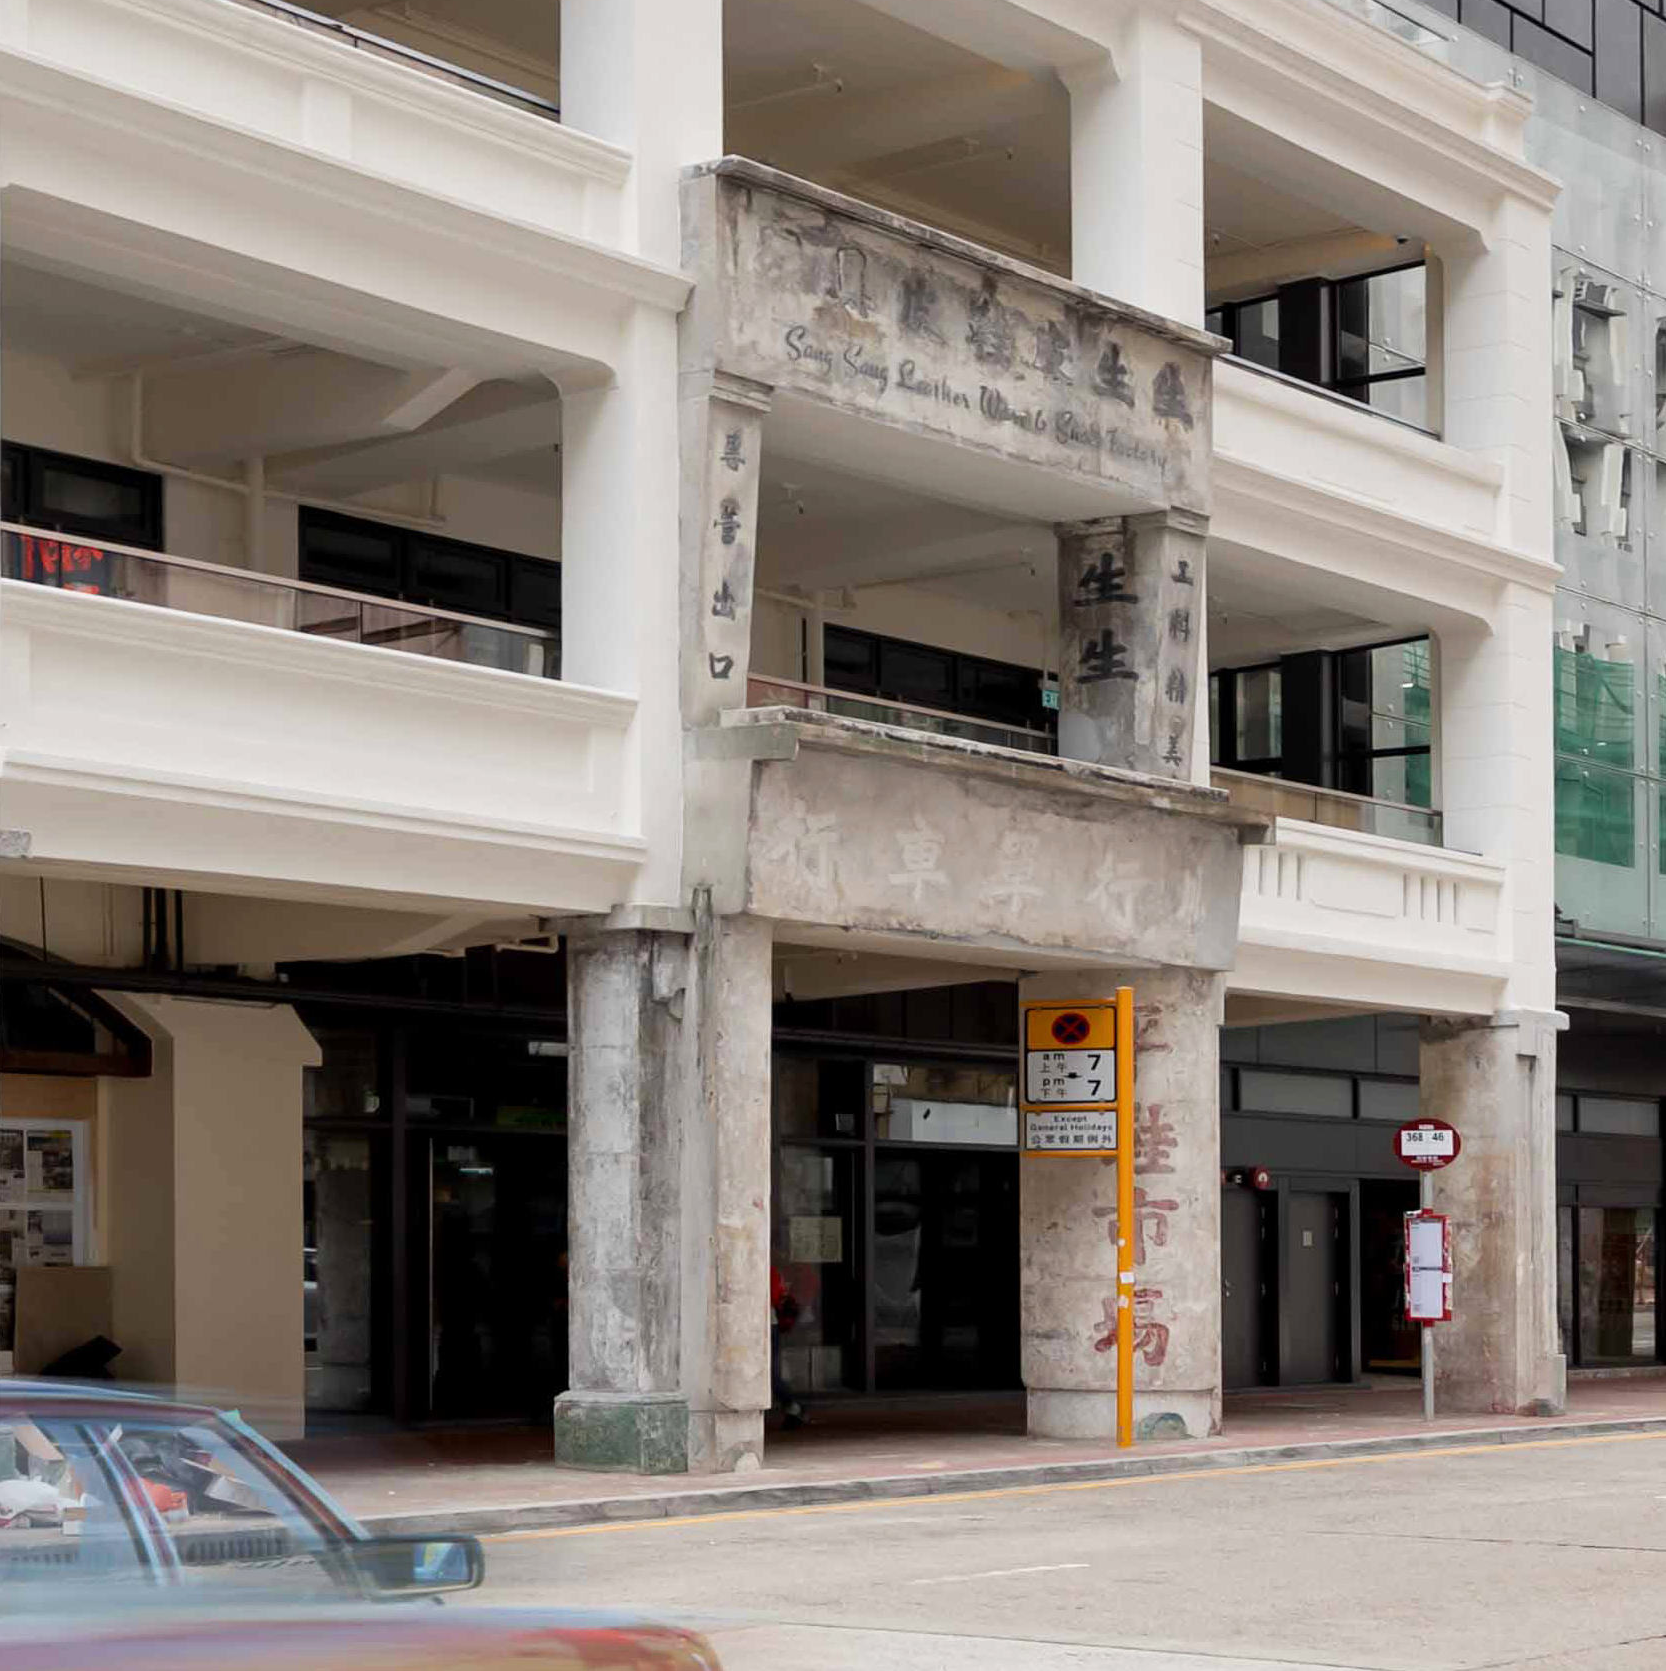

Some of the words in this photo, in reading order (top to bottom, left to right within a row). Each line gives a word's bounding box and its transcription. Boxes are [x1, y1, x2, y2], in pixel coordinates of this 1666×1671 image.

[785, 326, 833, 376] Sang
[843, 344, 889, 394] Sang
[1074, 552, 1139, 683] 生生
[1040, 1062, 1067, 1073] 上午
[1087, 1054, 1101, 1070] 7
[1040, 1088, 1067, 1098] 下午
[1087, 1080, 1101, 1096] 7
[1054, 1115, 1087, 1123] Except
[1030, 1123, 1067, 1131] General
[1070, 1123, 1112, 1132] Holidays
